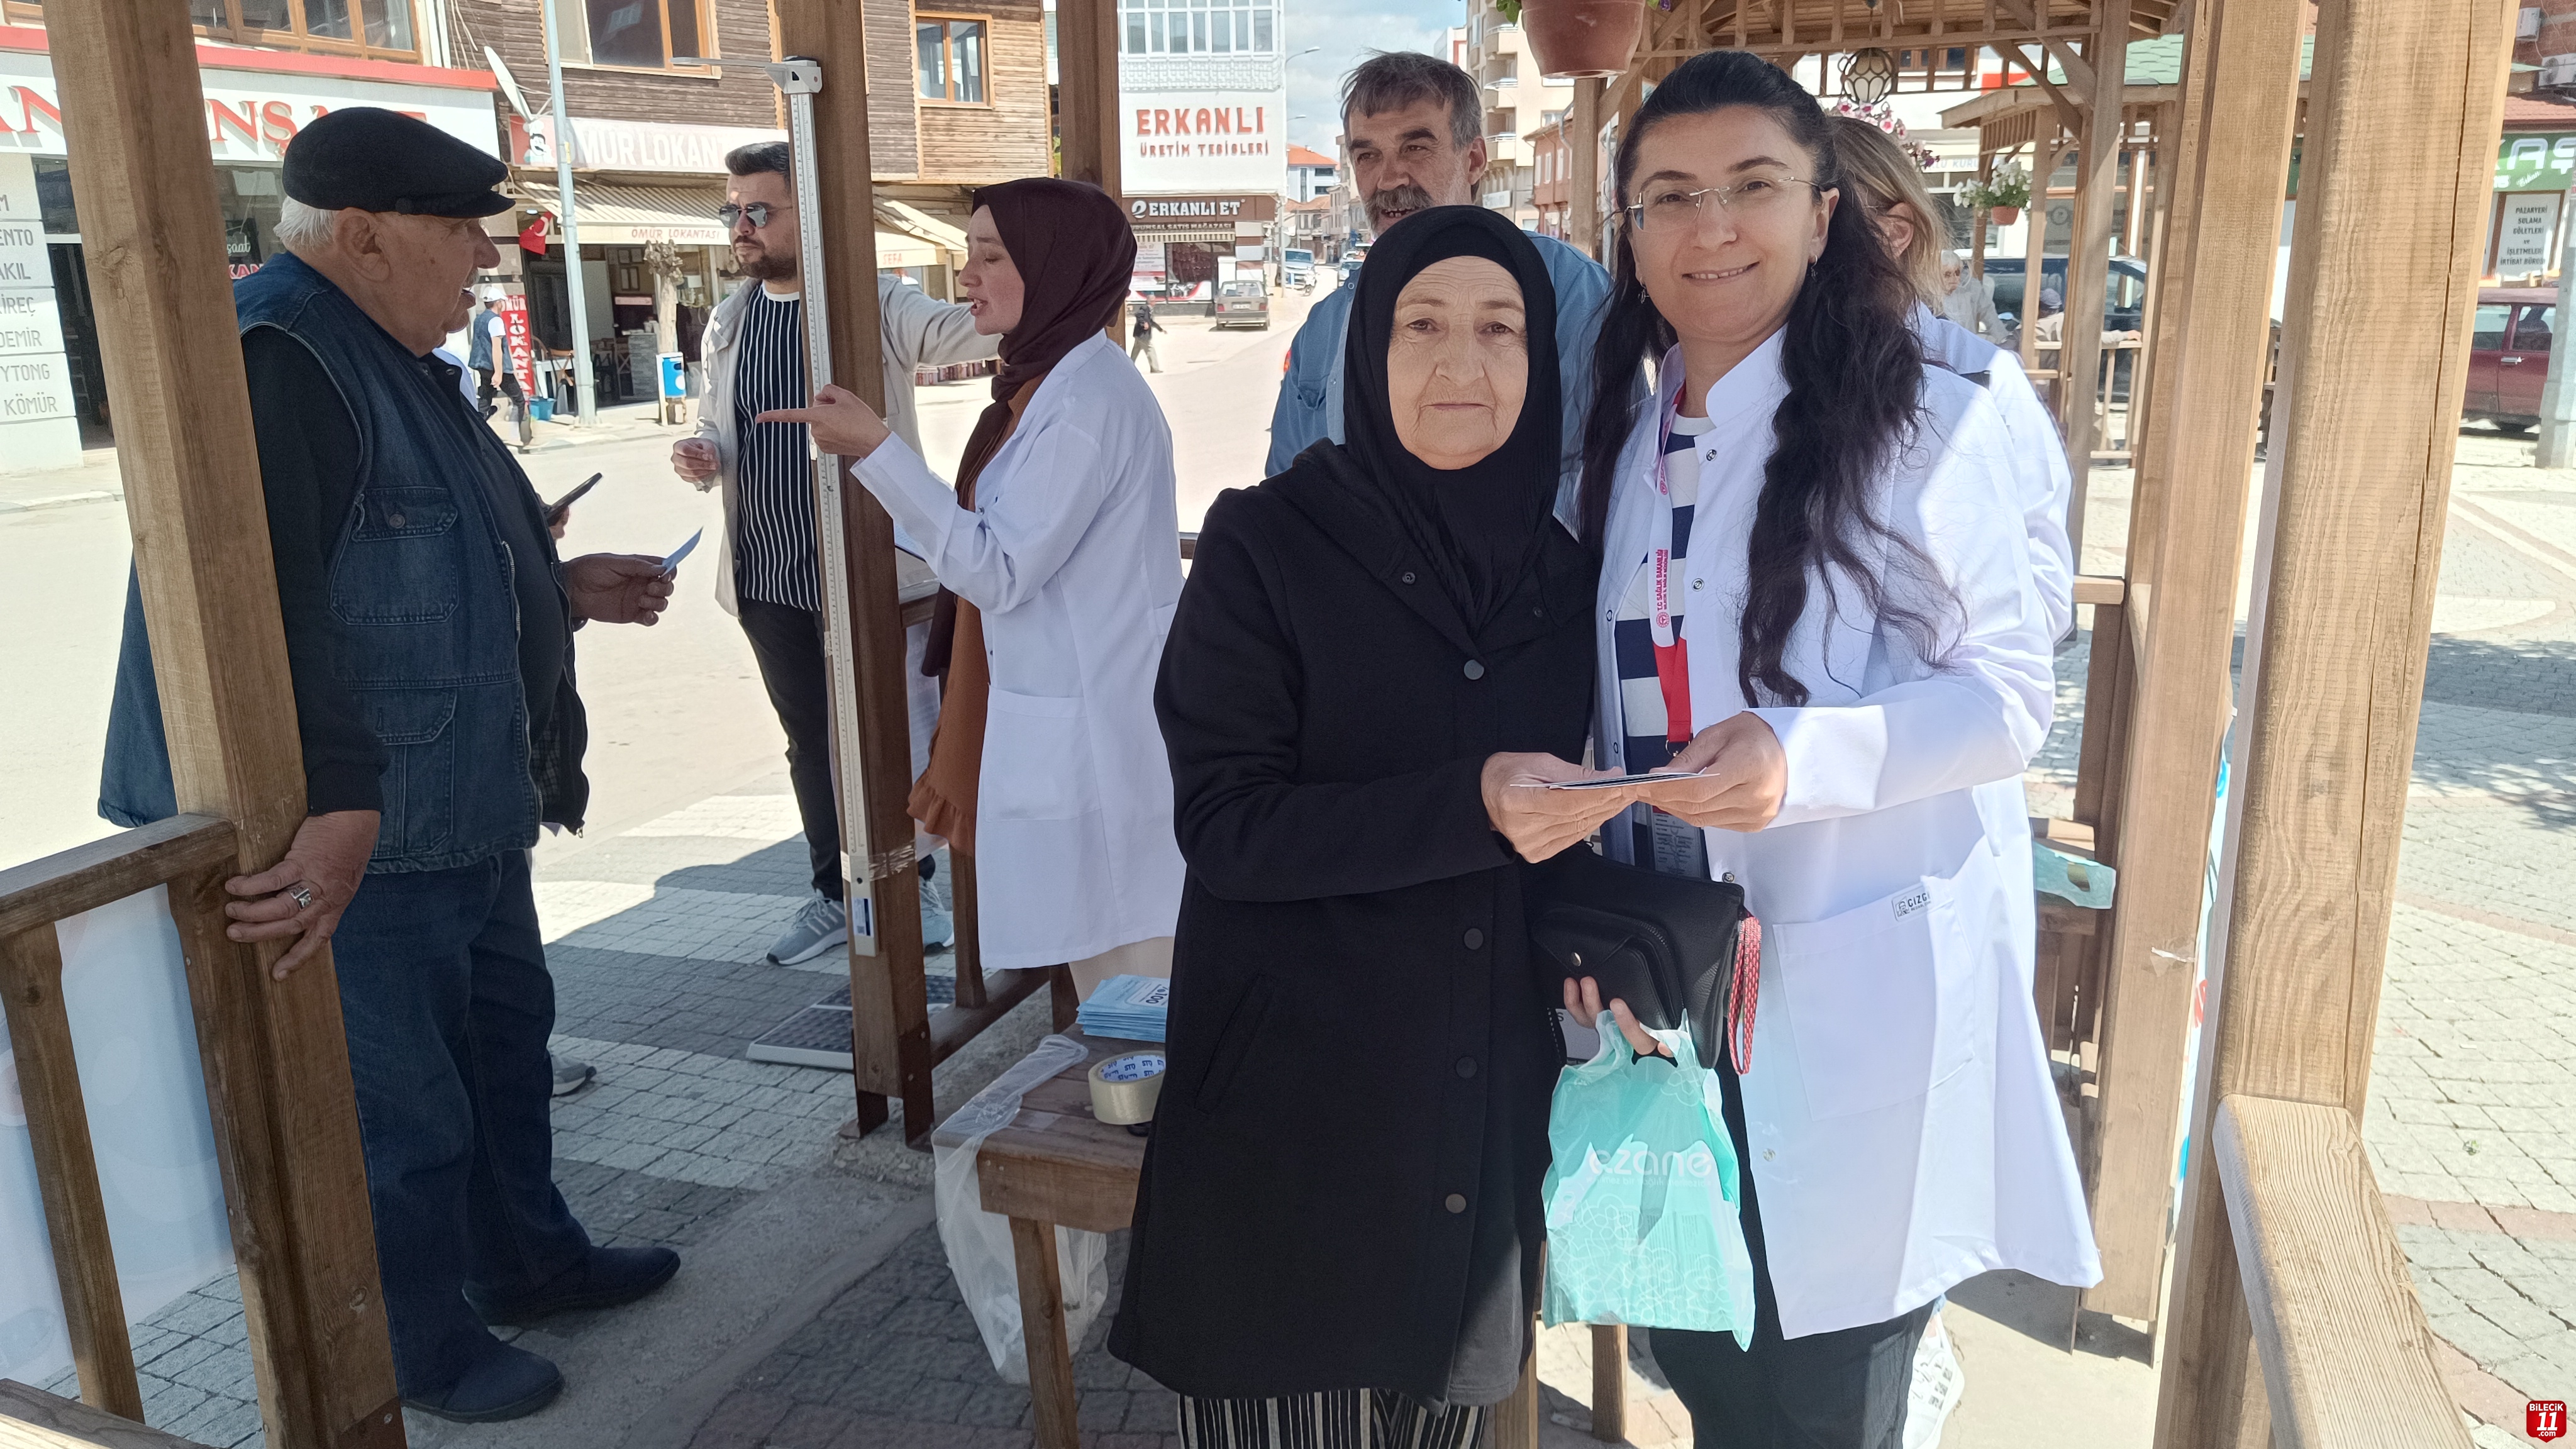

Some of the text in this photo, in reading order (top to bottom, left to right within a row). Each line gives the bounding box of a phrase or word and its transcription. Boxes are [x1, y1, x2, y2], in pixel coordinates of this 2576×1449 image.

[1136, 107, 1263, 136] ERKANLI
[1140, 141, 1190, 157] ÜRETİM
[1149, 201, 1240, 216] ERKANLI ET
[669, 228, 720, 240] LOKANTASI
[883, 253, 902, 265] SEFA
[4, 392, 58, 416] KÖMÜR
